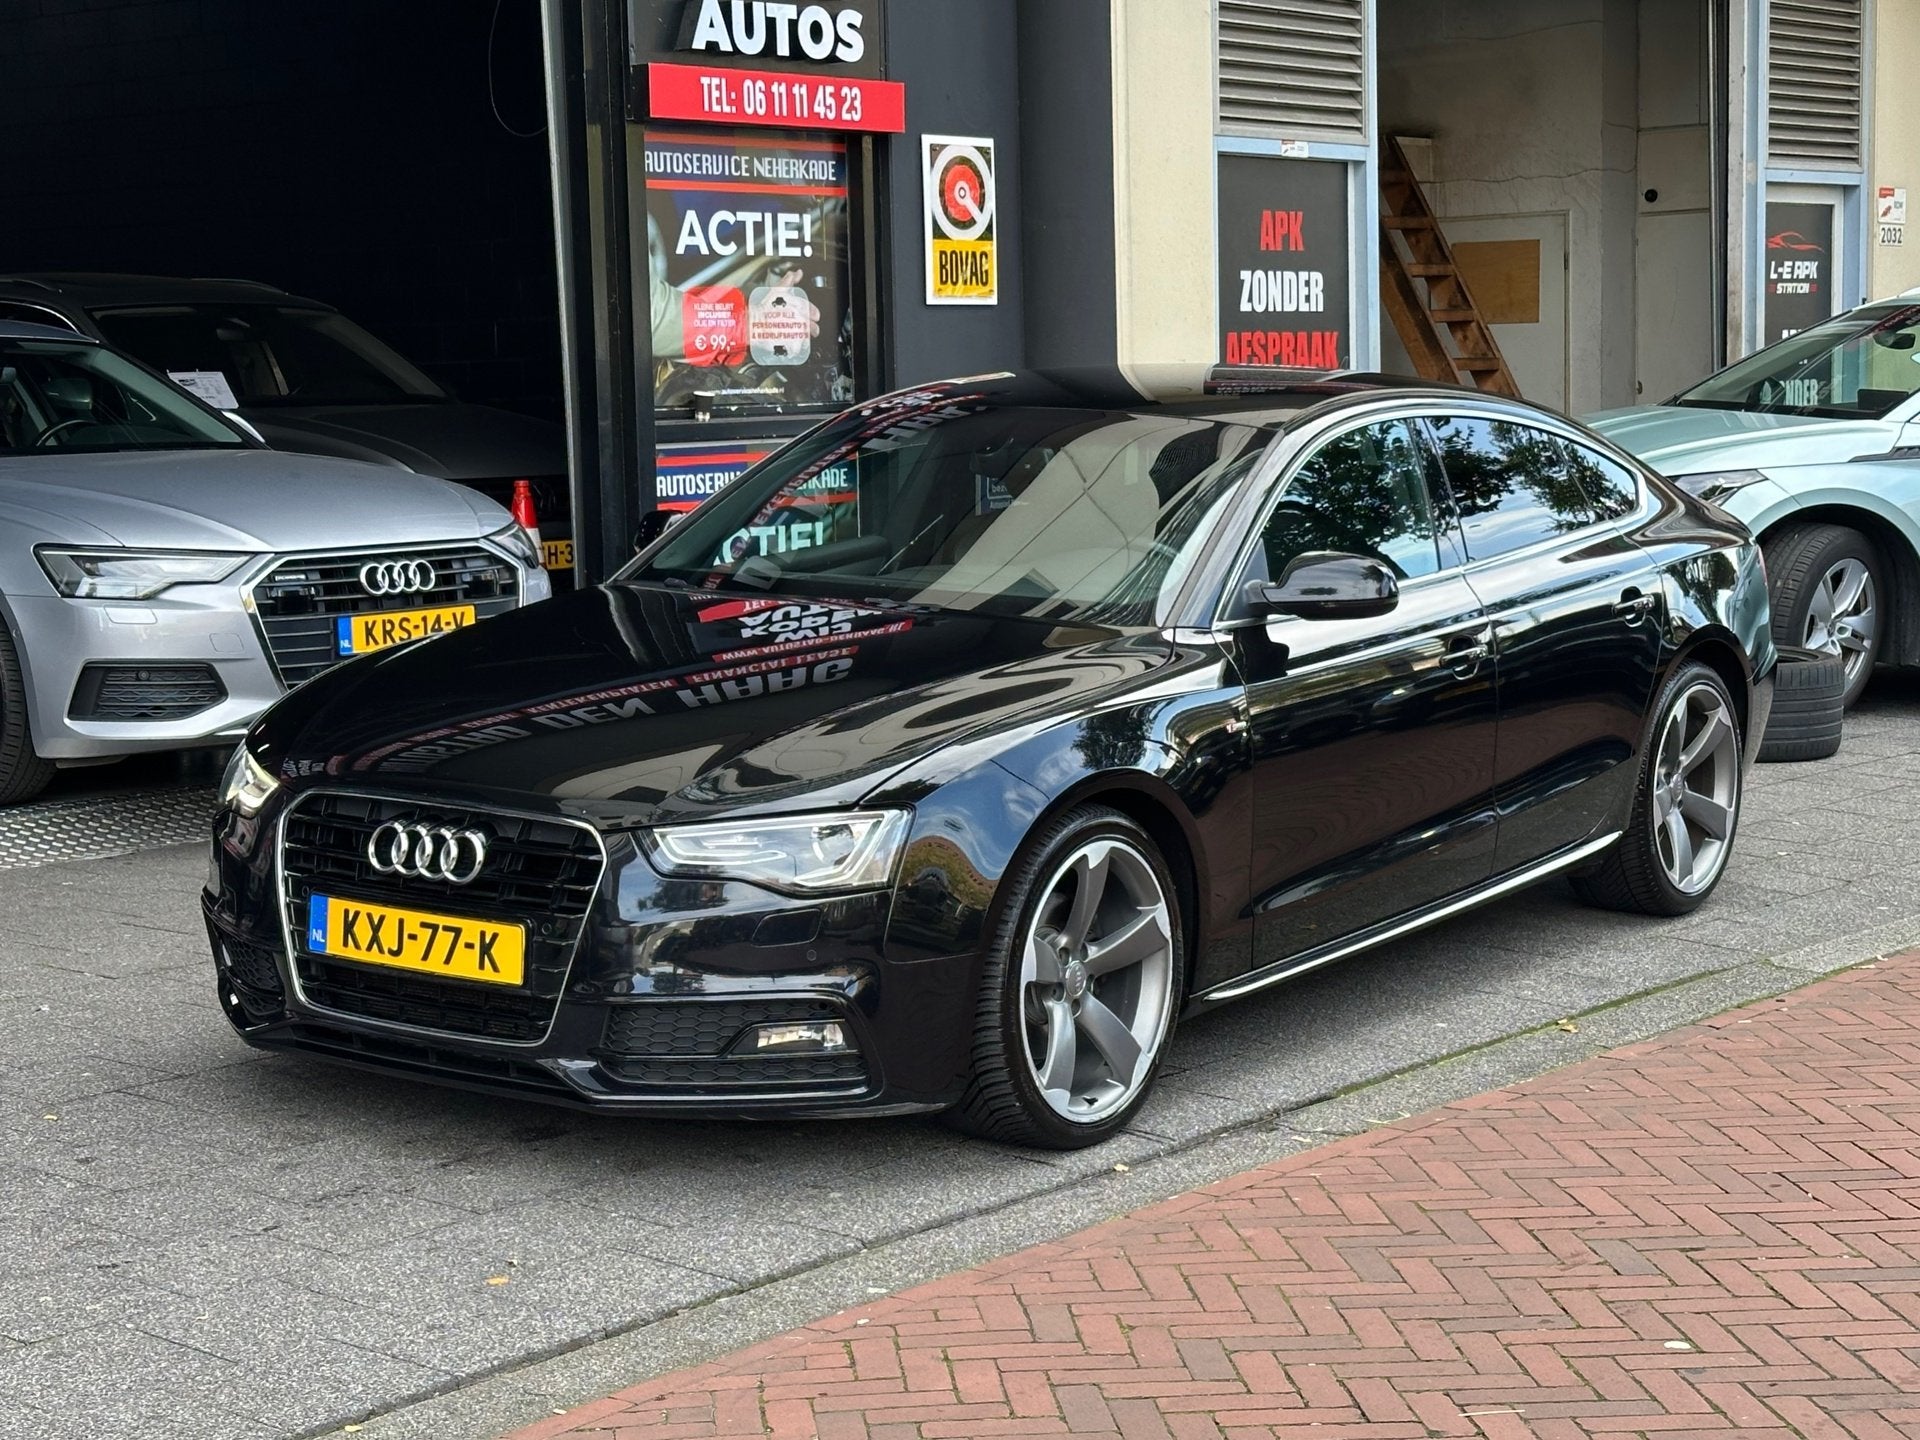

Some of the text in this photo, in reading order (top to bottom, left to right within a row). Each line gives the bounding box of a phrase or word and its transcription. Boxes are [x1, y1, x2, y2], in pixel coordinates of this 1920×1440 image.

[692, 0, 864, 62] AUTOS
[701, 77, 862, 122] TEL: 06 11 11 45 23
[753, 157, 836, 181] NEHERKADE
[676, 210, 813, 257] ACTIE!
[1260, 210, 1304, 251] APK
[1881, 227, 1903, 244] 2032
[939, 250, 989, 286] BOVAG
[1240, 269, 1324, 313] ZONDER
[1776, 283, 1809, 294] STATION
[695, 334, 736, 352] € 99,-
[1226, 331, 1339, 369] AFSPRAAK
[1779, 378, 1819, 406] NDER
[340, 639, 352, 648] NL
[364, 611, 465, 647] KRS-14-V
[312, 929, 326, 943] NL
[341, 908, 501, 973] KXJ-77-K
